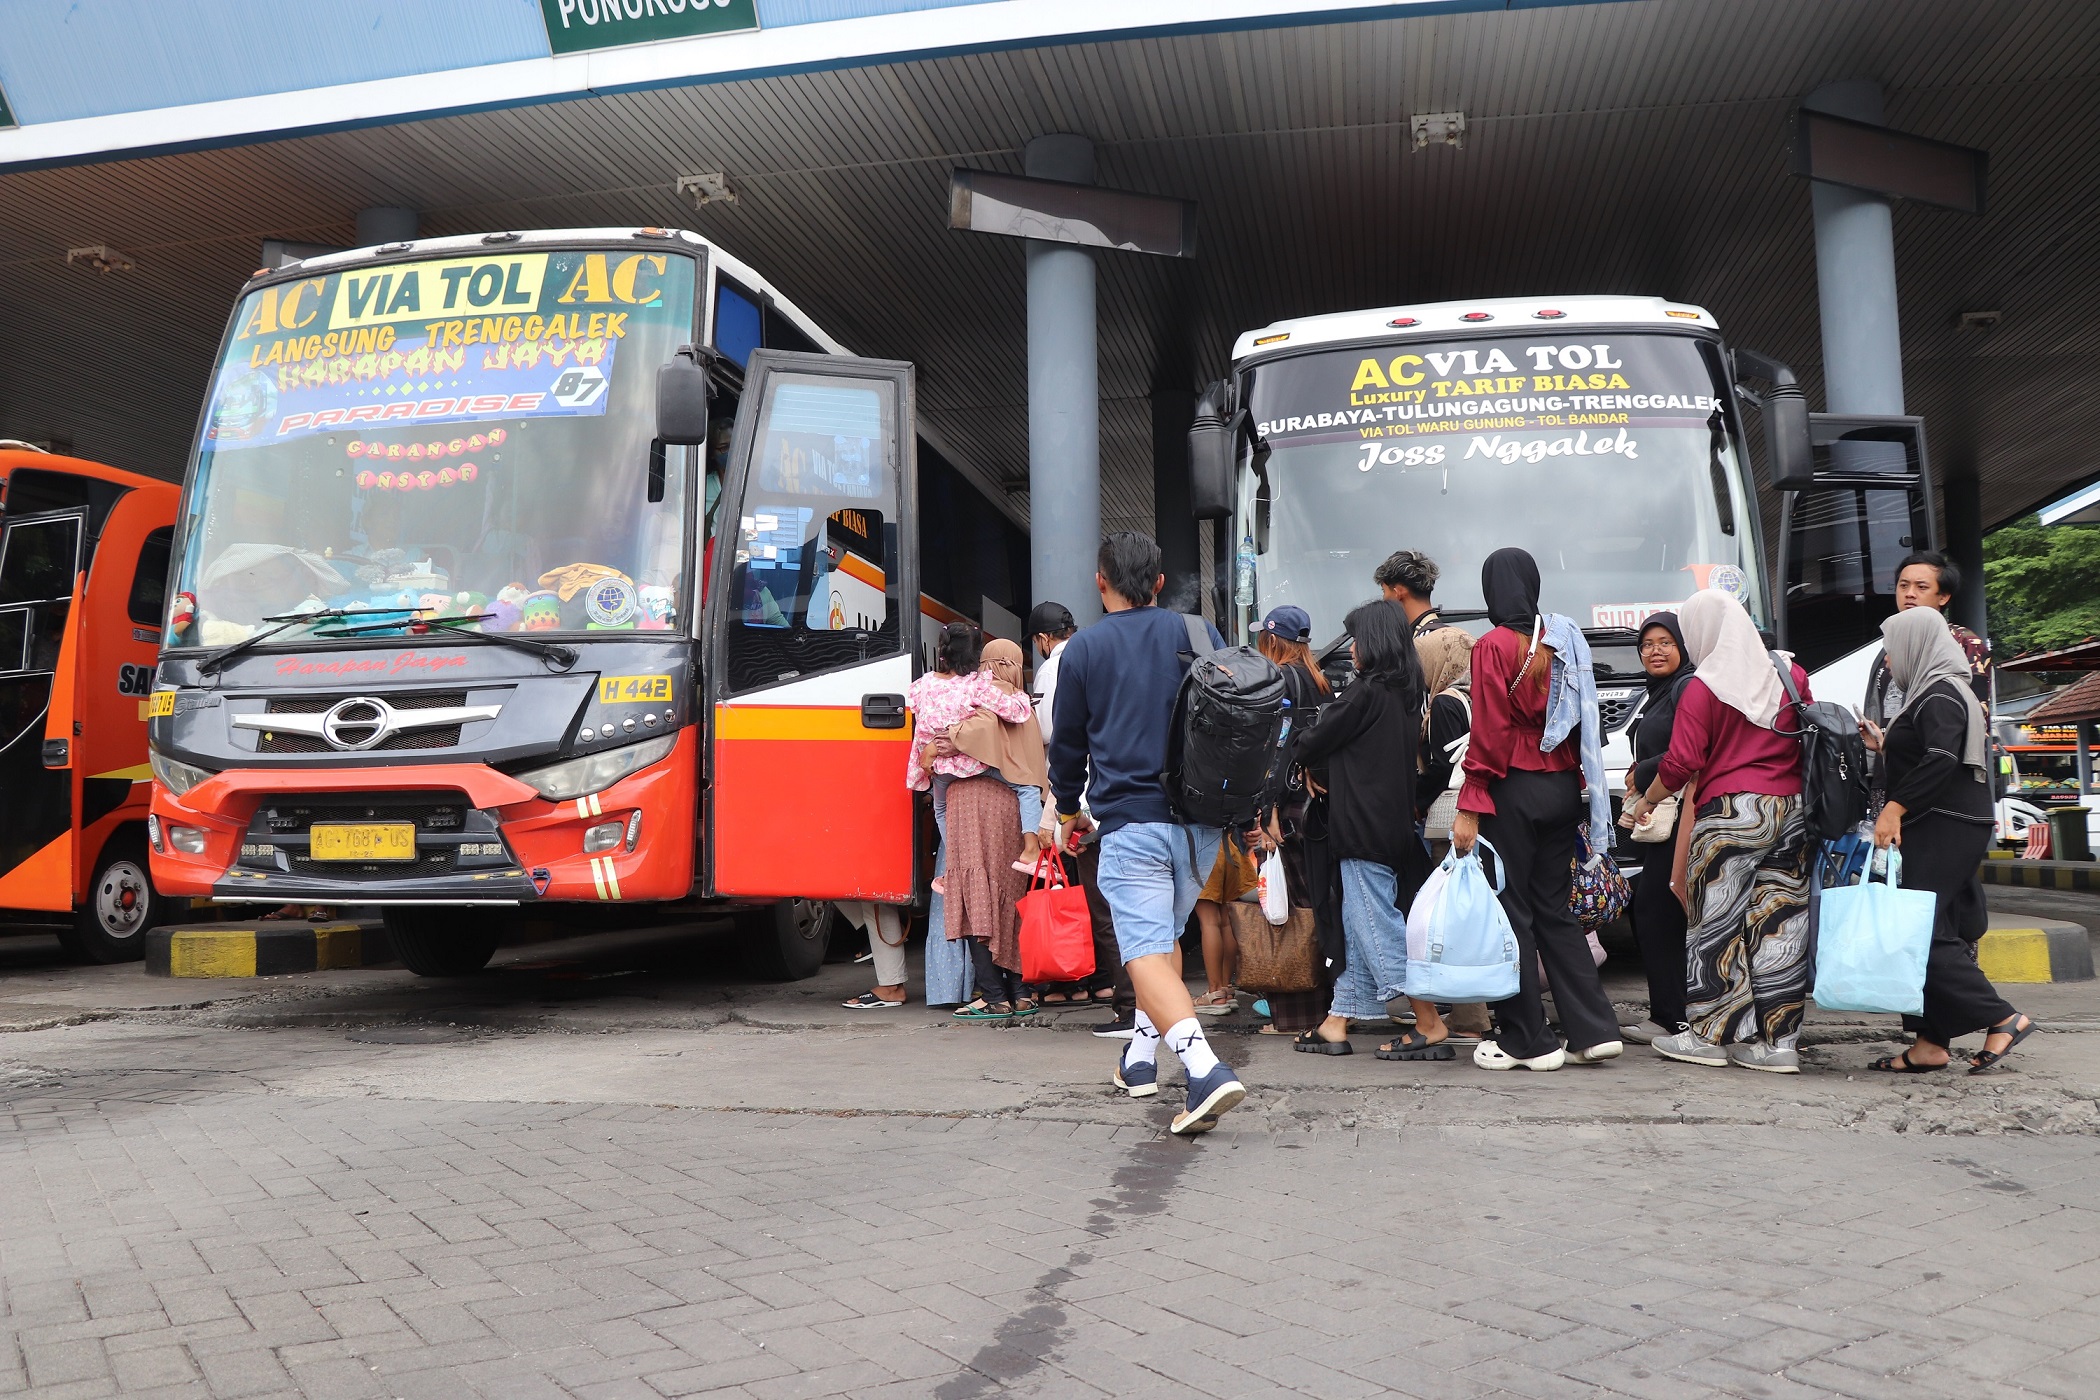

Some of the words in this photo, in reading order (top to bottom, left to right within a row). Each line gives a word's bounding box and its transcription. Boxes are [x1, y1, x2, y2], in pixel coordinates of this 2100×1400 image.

[348, 271, 420, 318] VIA
[441, 263, 531, 309] TOL
[558, 254, 667, 304] AC
[238, 278, 326, 340] AC
[250, 326, 396, 368] LANGSUNG
[425, 313, 628, 348] TRENGGALEK
[278, 345, 465, 393] HARAPAN
[483, 337, 608, 370] JAYA
[1351, 355, 1425, 390] AC
[1425, 349, 1518, 377] VIA
[1526, 344, 1622, 370] TOL
[555, 373, 603, 401] 87
[1351, 389, 1426, 406] Luxury
[1431, 376, 1526, 397] TARIF
[1533, 373, 1630, 392] BIASA
[276, 392, 547, 436] PARADISE
[1360, 427, 1382, 438] VIA
[1386, 424, 1414, 435] TOL
[1417, 420, 1460, 433] WARU
[1463, 416, 1525, 430] GUNUNG
[1537, 414, 1565, 426] TOL
[1569, 412, 1629, 425] BANDAR
[347, 428, 502, 457] GARANGAN
[1358, 442, 1446, 472] Joss
[358, 468, 472, 488] INSYAF
[842, 510, 867, 539] BIASA
[1597, 608, 1679, 632] SURA
[275, 658, 387, 677] Harapan
[389, 651, 469, 675] Jaya
[605, 681, 619, 699] H
[625, 679, 667, 698] 442
[390, 828, 409, 847] US
